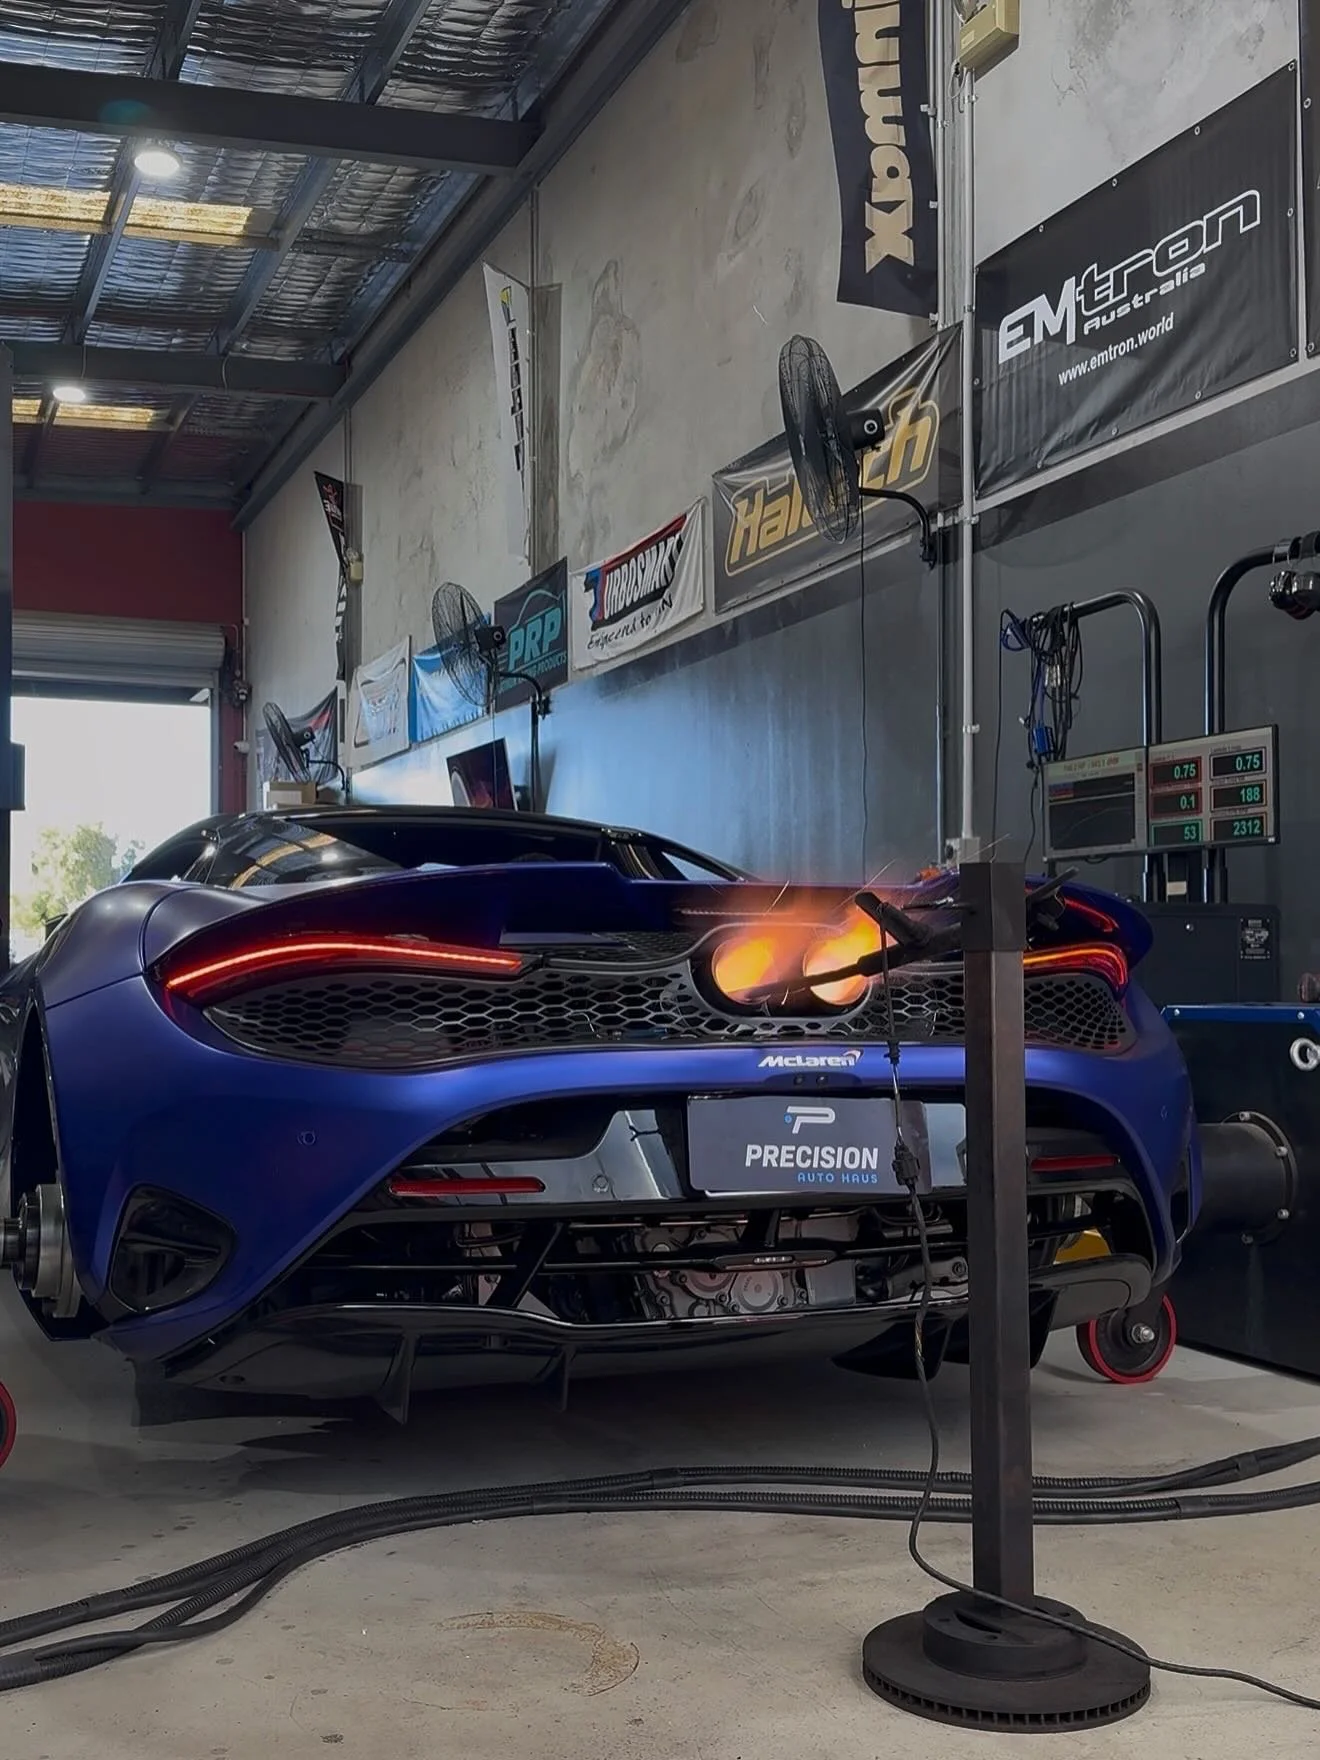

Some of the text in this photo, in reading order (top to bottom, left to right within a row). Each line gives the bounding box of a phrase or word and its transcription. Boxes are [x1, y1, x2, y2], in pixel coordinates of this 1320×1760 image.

[999, 189, 1261, 365] EMtron
[1083, 262, 1206, 336] Australia
[1058, 312, 1175, 386] www.emtron.world
[729, 402, 933, 565] Halch
[507, 606, 562, 672] PRP
[1235, 754, 1260, 772] 0.75
[1174, 764, 1196, 780] 0.75
[1180, 795, 1196, 810] 0.1
[1240, 787, 1261, 803] 188
[1184, 826, 1197, 841] 53
[1233, 820, 1261, 837] 2312
[757, 1053, 858, 1068] McLaren
[745, 1143, 878, 1170] PRECISION
[797, 1172, 878, 1184] AUTO HAUS
